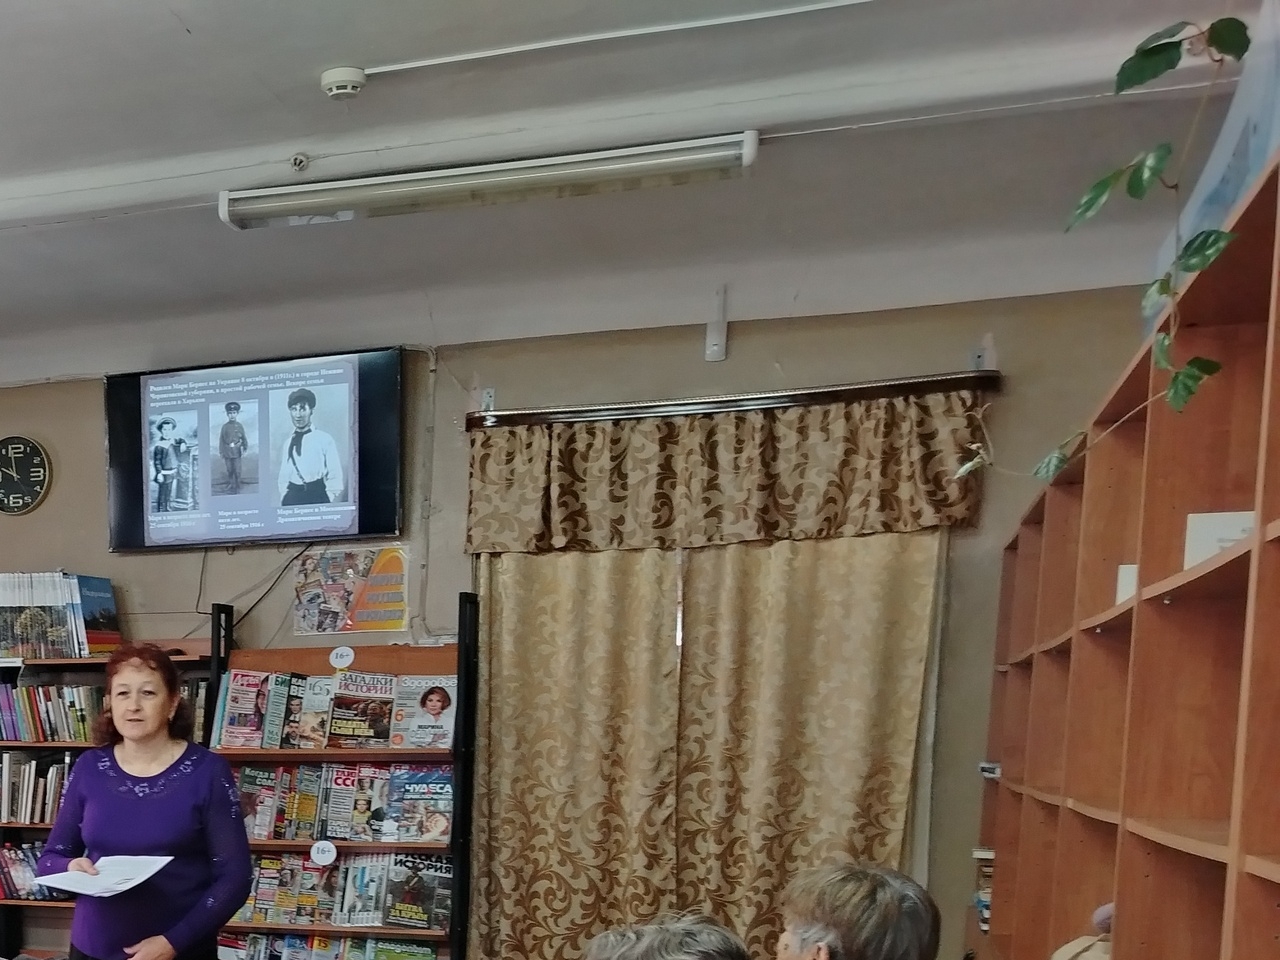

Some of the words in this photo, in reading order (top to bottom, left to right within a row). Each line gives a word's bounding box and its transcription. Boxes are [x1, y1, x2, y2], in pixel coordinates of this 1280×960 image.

[30, 467, 44, 481] 3
[9, 493, 23, 507] 6
[334, 651, 351, 660] 16+
[340, 672, 393, 686] ЗАГАДКИ
[401, 676, 458, 689] Здоровье
[338, 682, 393, 695] ИСТОРИИ
[316, 846, 333, 856] 16+
[394, 858, 453, 875] ИСТОРИЯ
